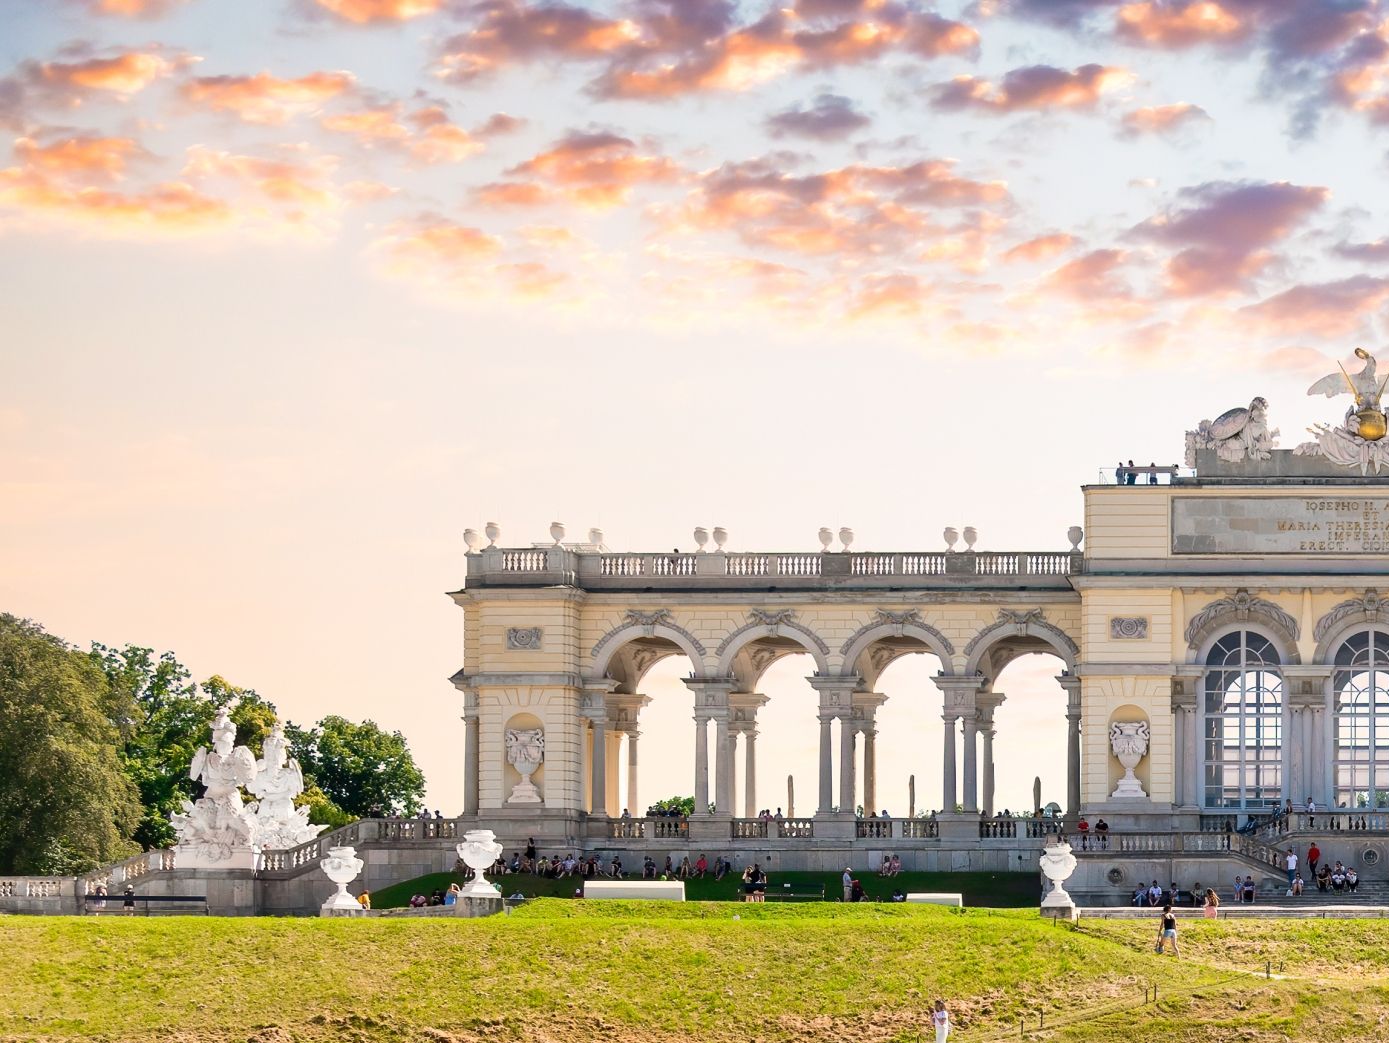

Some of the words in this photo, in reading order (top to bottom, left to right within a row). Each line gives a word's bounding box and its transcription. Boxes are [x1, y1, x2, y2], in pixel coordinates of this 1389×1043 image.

[1305, 501, 1359, 511] IOSEPHO
[1362, 511, 1380, 521] ET
[1277, 521, 1321, 531] MARIA
[1300, 541, 1349, 551] ERECT.
